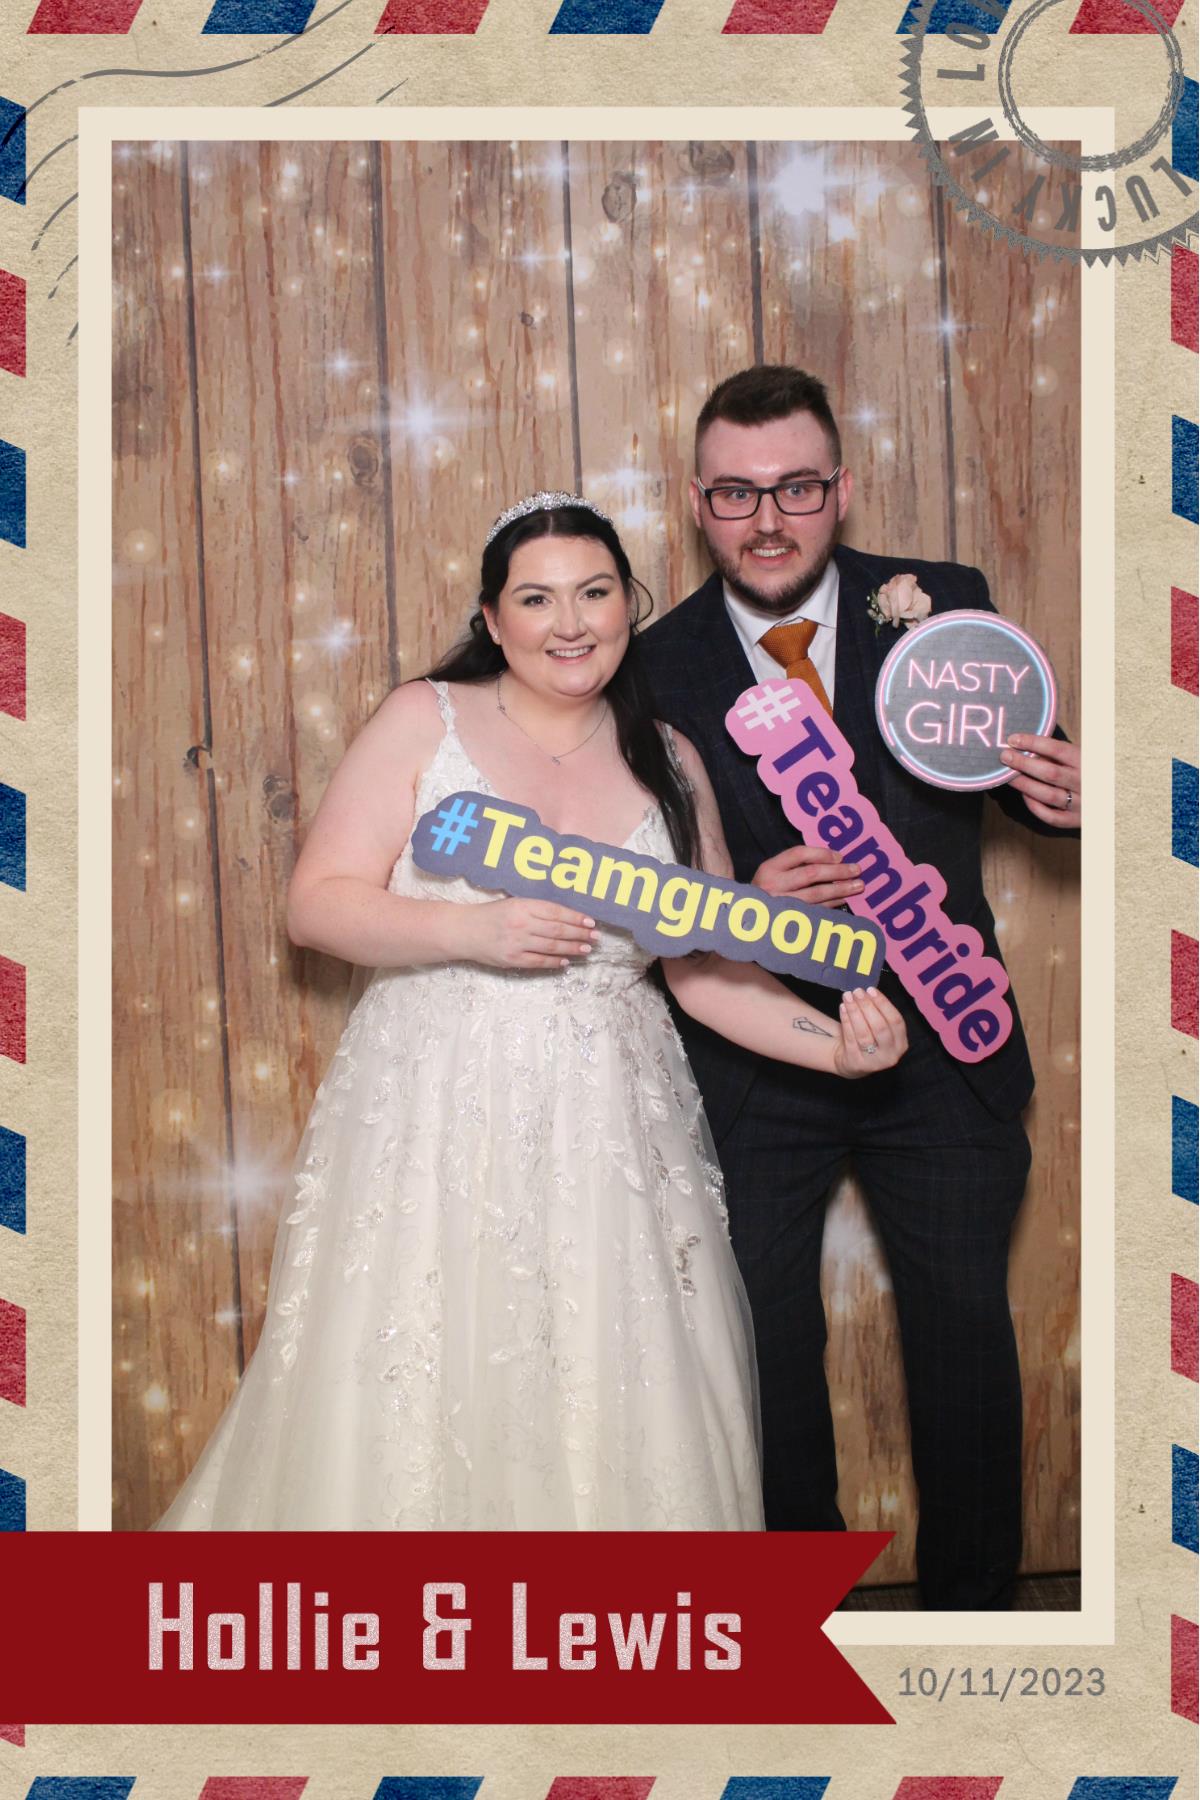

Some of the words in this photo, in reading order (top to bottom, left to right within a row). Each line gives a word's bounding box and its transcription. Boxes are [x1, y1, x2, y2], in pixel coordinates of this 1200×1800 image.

[904, 701, 1012, 749] GIRL
[907, 658, 1030, 694] NASTY
[430, 798, 879, 976] #Teamgroom
[736, 684, 1000, 1053] #Teambride
